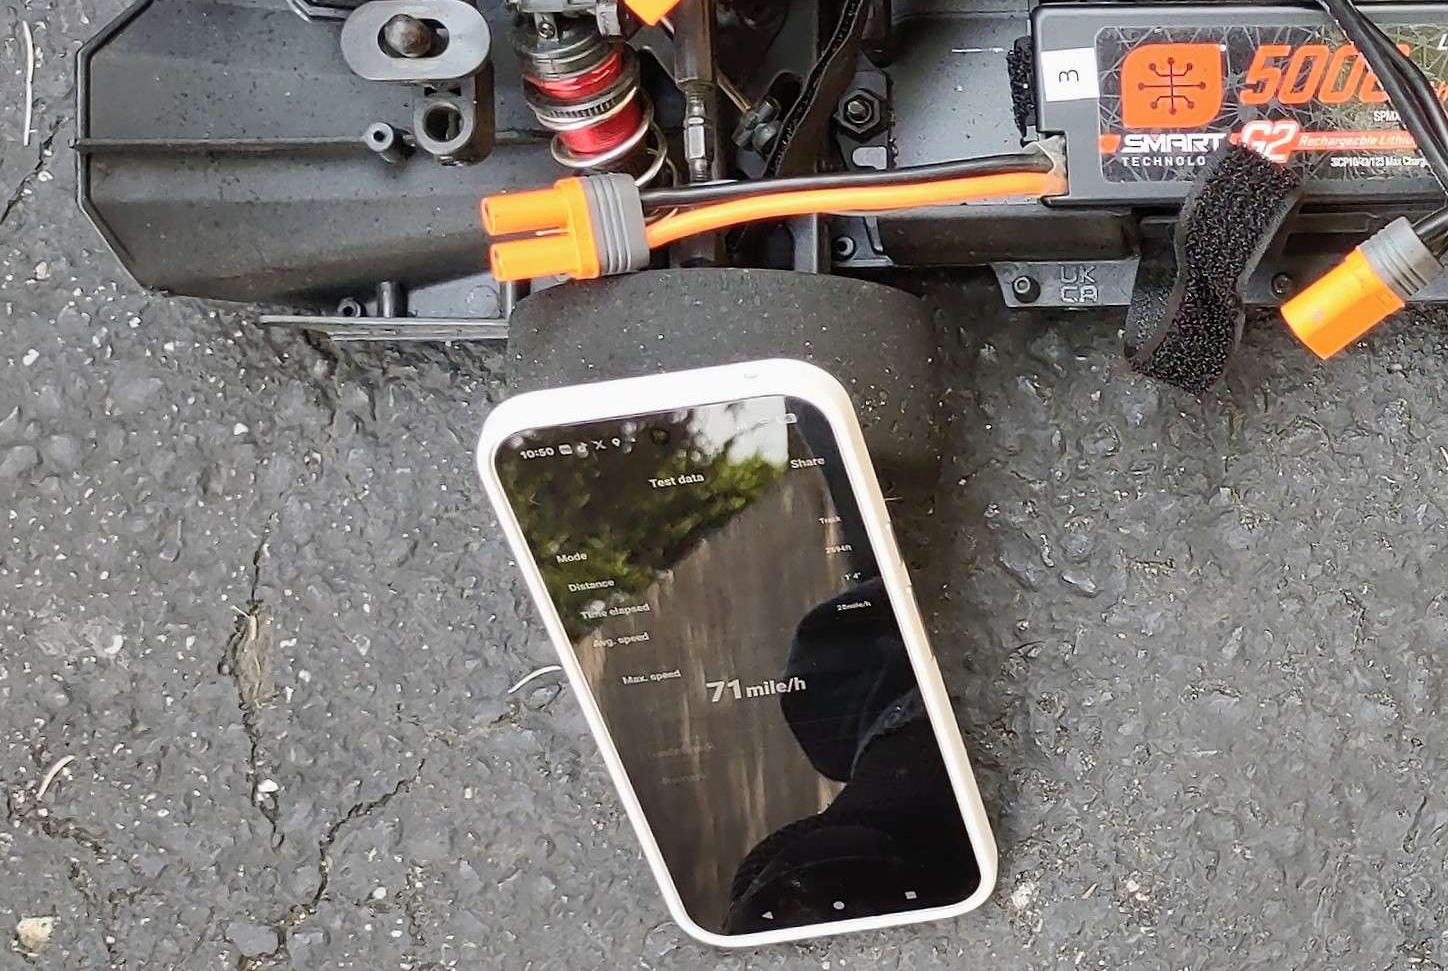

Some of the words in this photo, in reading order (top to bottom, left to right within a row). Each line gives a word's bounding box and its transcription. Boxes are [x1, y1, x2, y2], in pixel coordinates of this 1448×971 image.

[1122, 133, 1226, 153] SMART
[1299, 134, 1376, 148] Rechargeable
[1122, 156, 1206, 166] TECHNOLO
[1386, 157, 1402, 166] Max
[1403, 156, 1428, 168] Charg
[1060, 266, 1097, 283] UK
[520, 446, 554, 460] 10:50
[790, 457, 825, 470] Share
[649, 476, 677, 489] Test
[678, 473, 704, 486] data
[556, 552, 587, 564] Mode
[568, 579, 615, 592] Distance
[580, 609, 607, 620] Time
[609, 603, 650, 617] elapsed
[593, 637, 617, 648] Avg.
[617, 632, 650, 644] speed
[622, 674, 649, 685] Max.
[650, 669, 681, 681] speed
[706, 679, 742, 703] 71
[745, 677, 807, 698] mile/h
